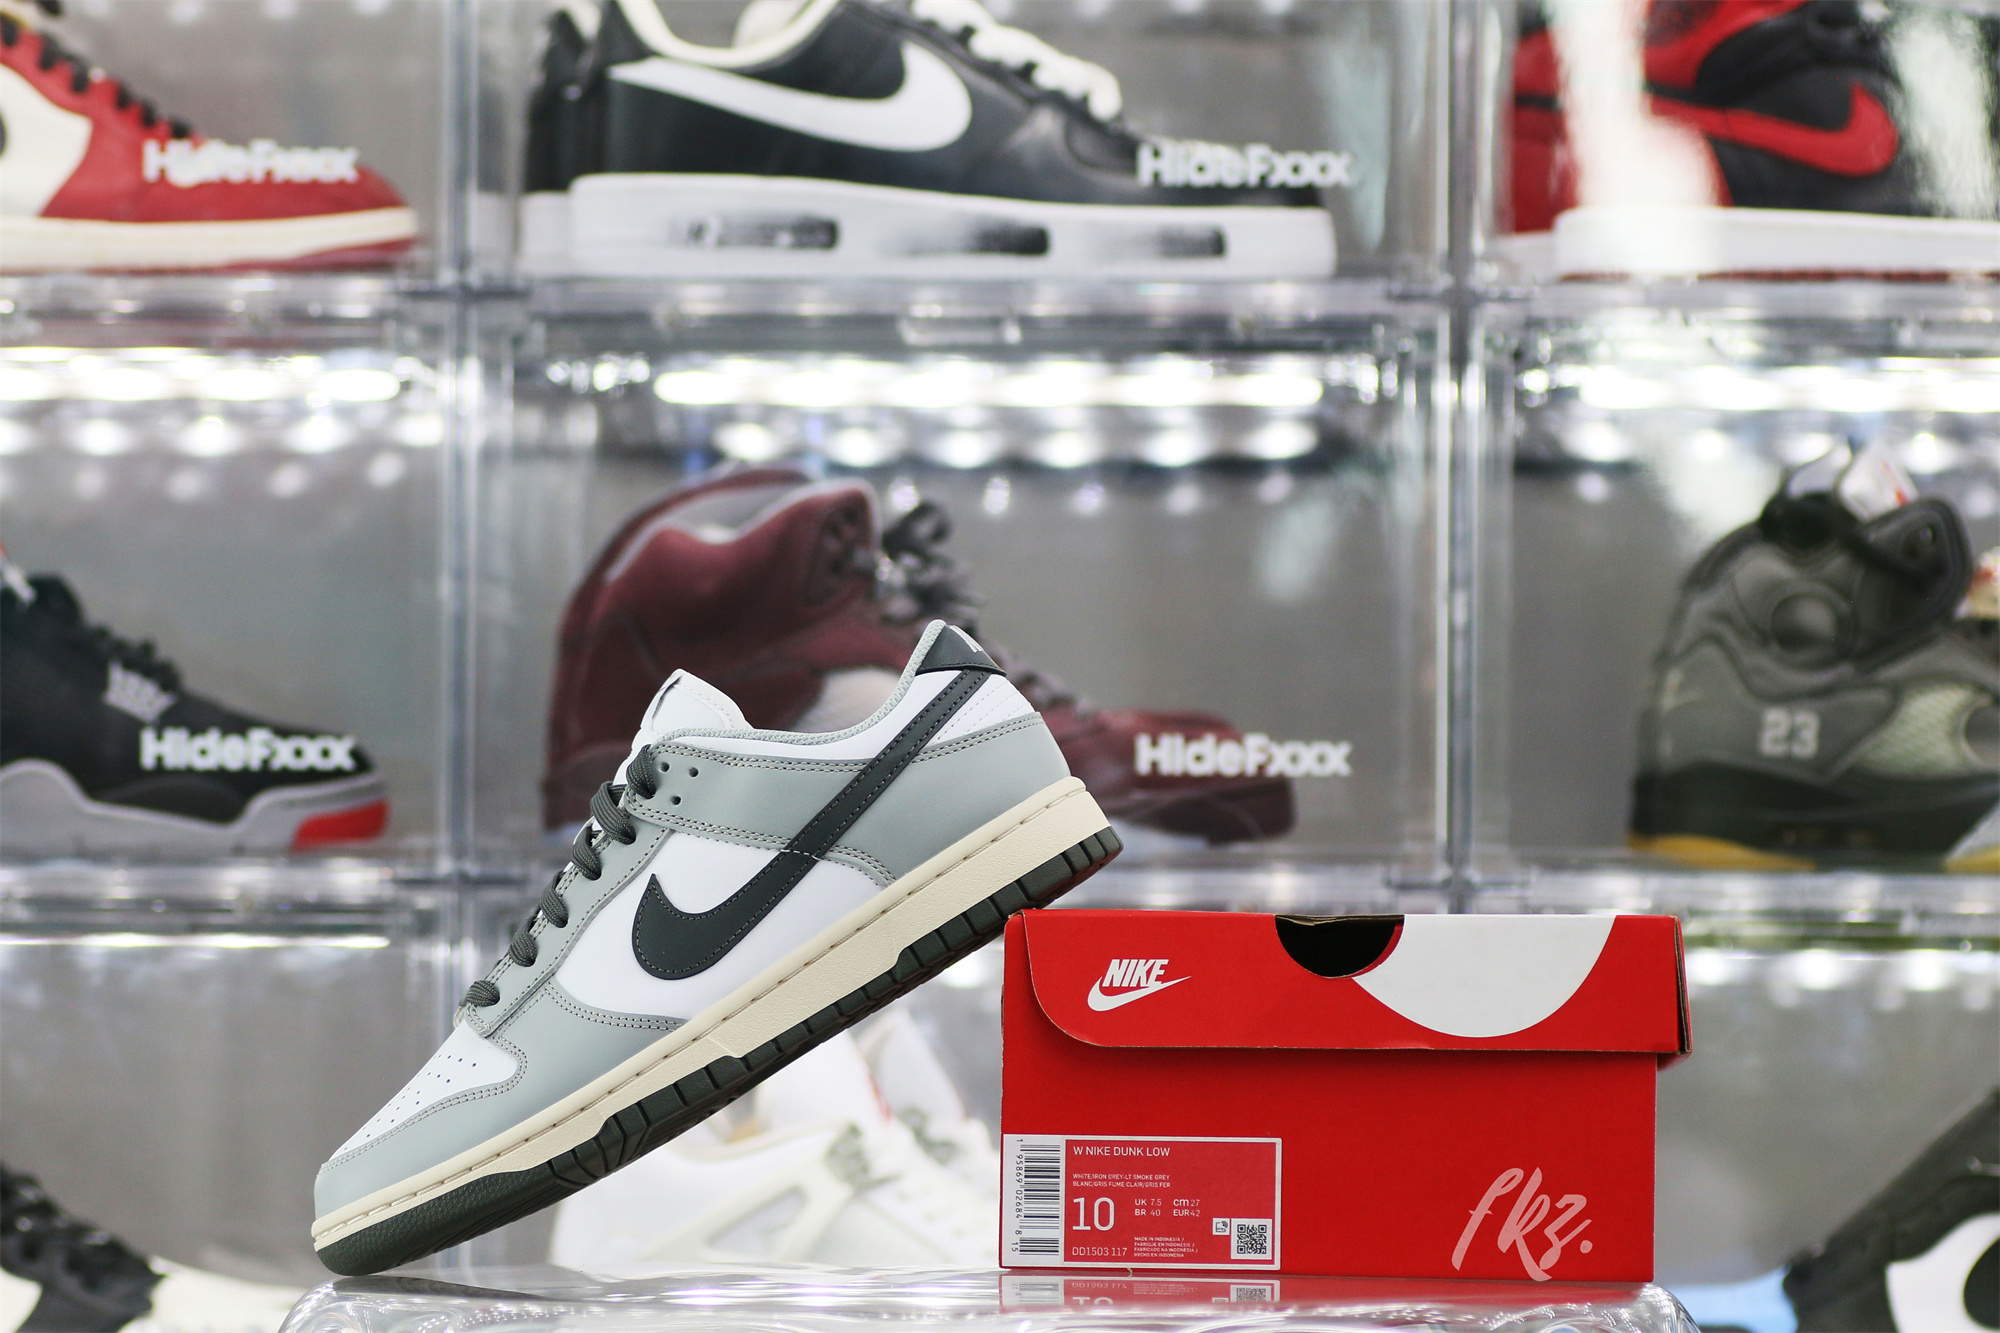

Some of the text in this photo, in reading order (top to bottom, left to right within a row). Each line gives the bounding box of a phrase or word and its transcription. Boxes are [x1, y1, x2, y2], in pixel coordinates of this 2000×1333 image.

[1761, 707, 1818, 759] 23
[1102, 959, 1169, 987] NIKE
[1073, 1146, 1170, 1157] W NIKE DUNK LOW
[1015, 1154, 1024, 1183] 95869
[1015, 1189, 1023, 1219] 02684
[1134, 1198, 1162, 1207] UK 7.5
[1190, 1199, 1200, 1207] 27
[1072, 1197, 1115, 1231] 10
[1134, 1208, 1147, 1216] BR
[1190, 1209, 1201, 1217] 42
[1011, 1242, 1019, 1252] 15
[1072, 1246, 1128, 1257] DD1503 117
